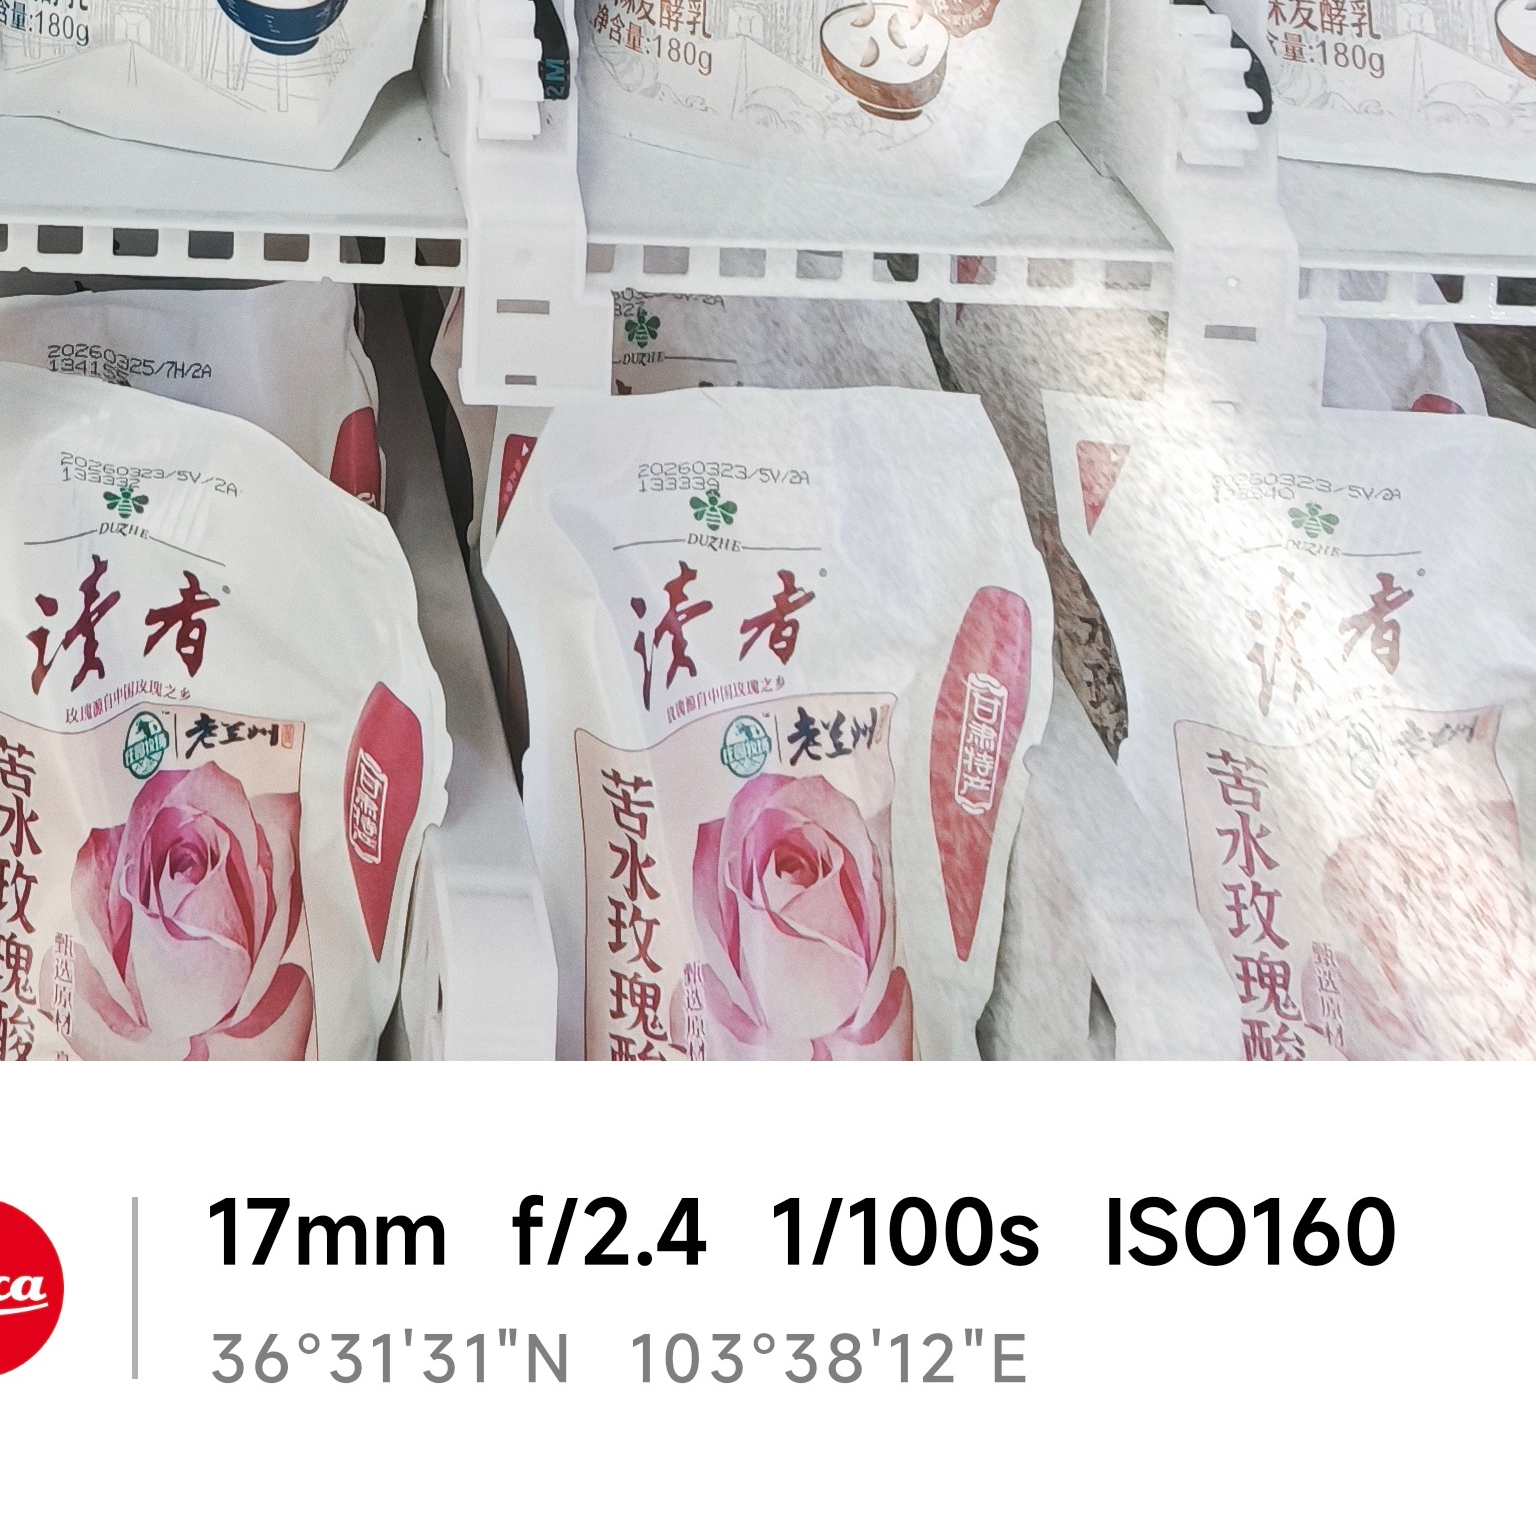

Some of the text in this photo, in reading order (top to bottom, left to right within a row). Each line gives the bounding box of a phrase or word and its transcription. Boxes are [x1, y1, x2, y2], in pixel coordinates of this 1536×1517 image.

[48, 344, 212, 380] 20260325/7H/2A
[61, 451, 238, 498] 20260323/5V/2A
[637, 462, 810, 486] 20260323/5V/2A
[98, 521, 150, 540] DUZHE
[687, 532, 741, 553] DUZHE
[26, 553, 221, 695] 读者
[630, 560, 816, 712] 读者
[184, 712, 279, 760] 老兰州
[787, 706, 879, 766] 老兰州
